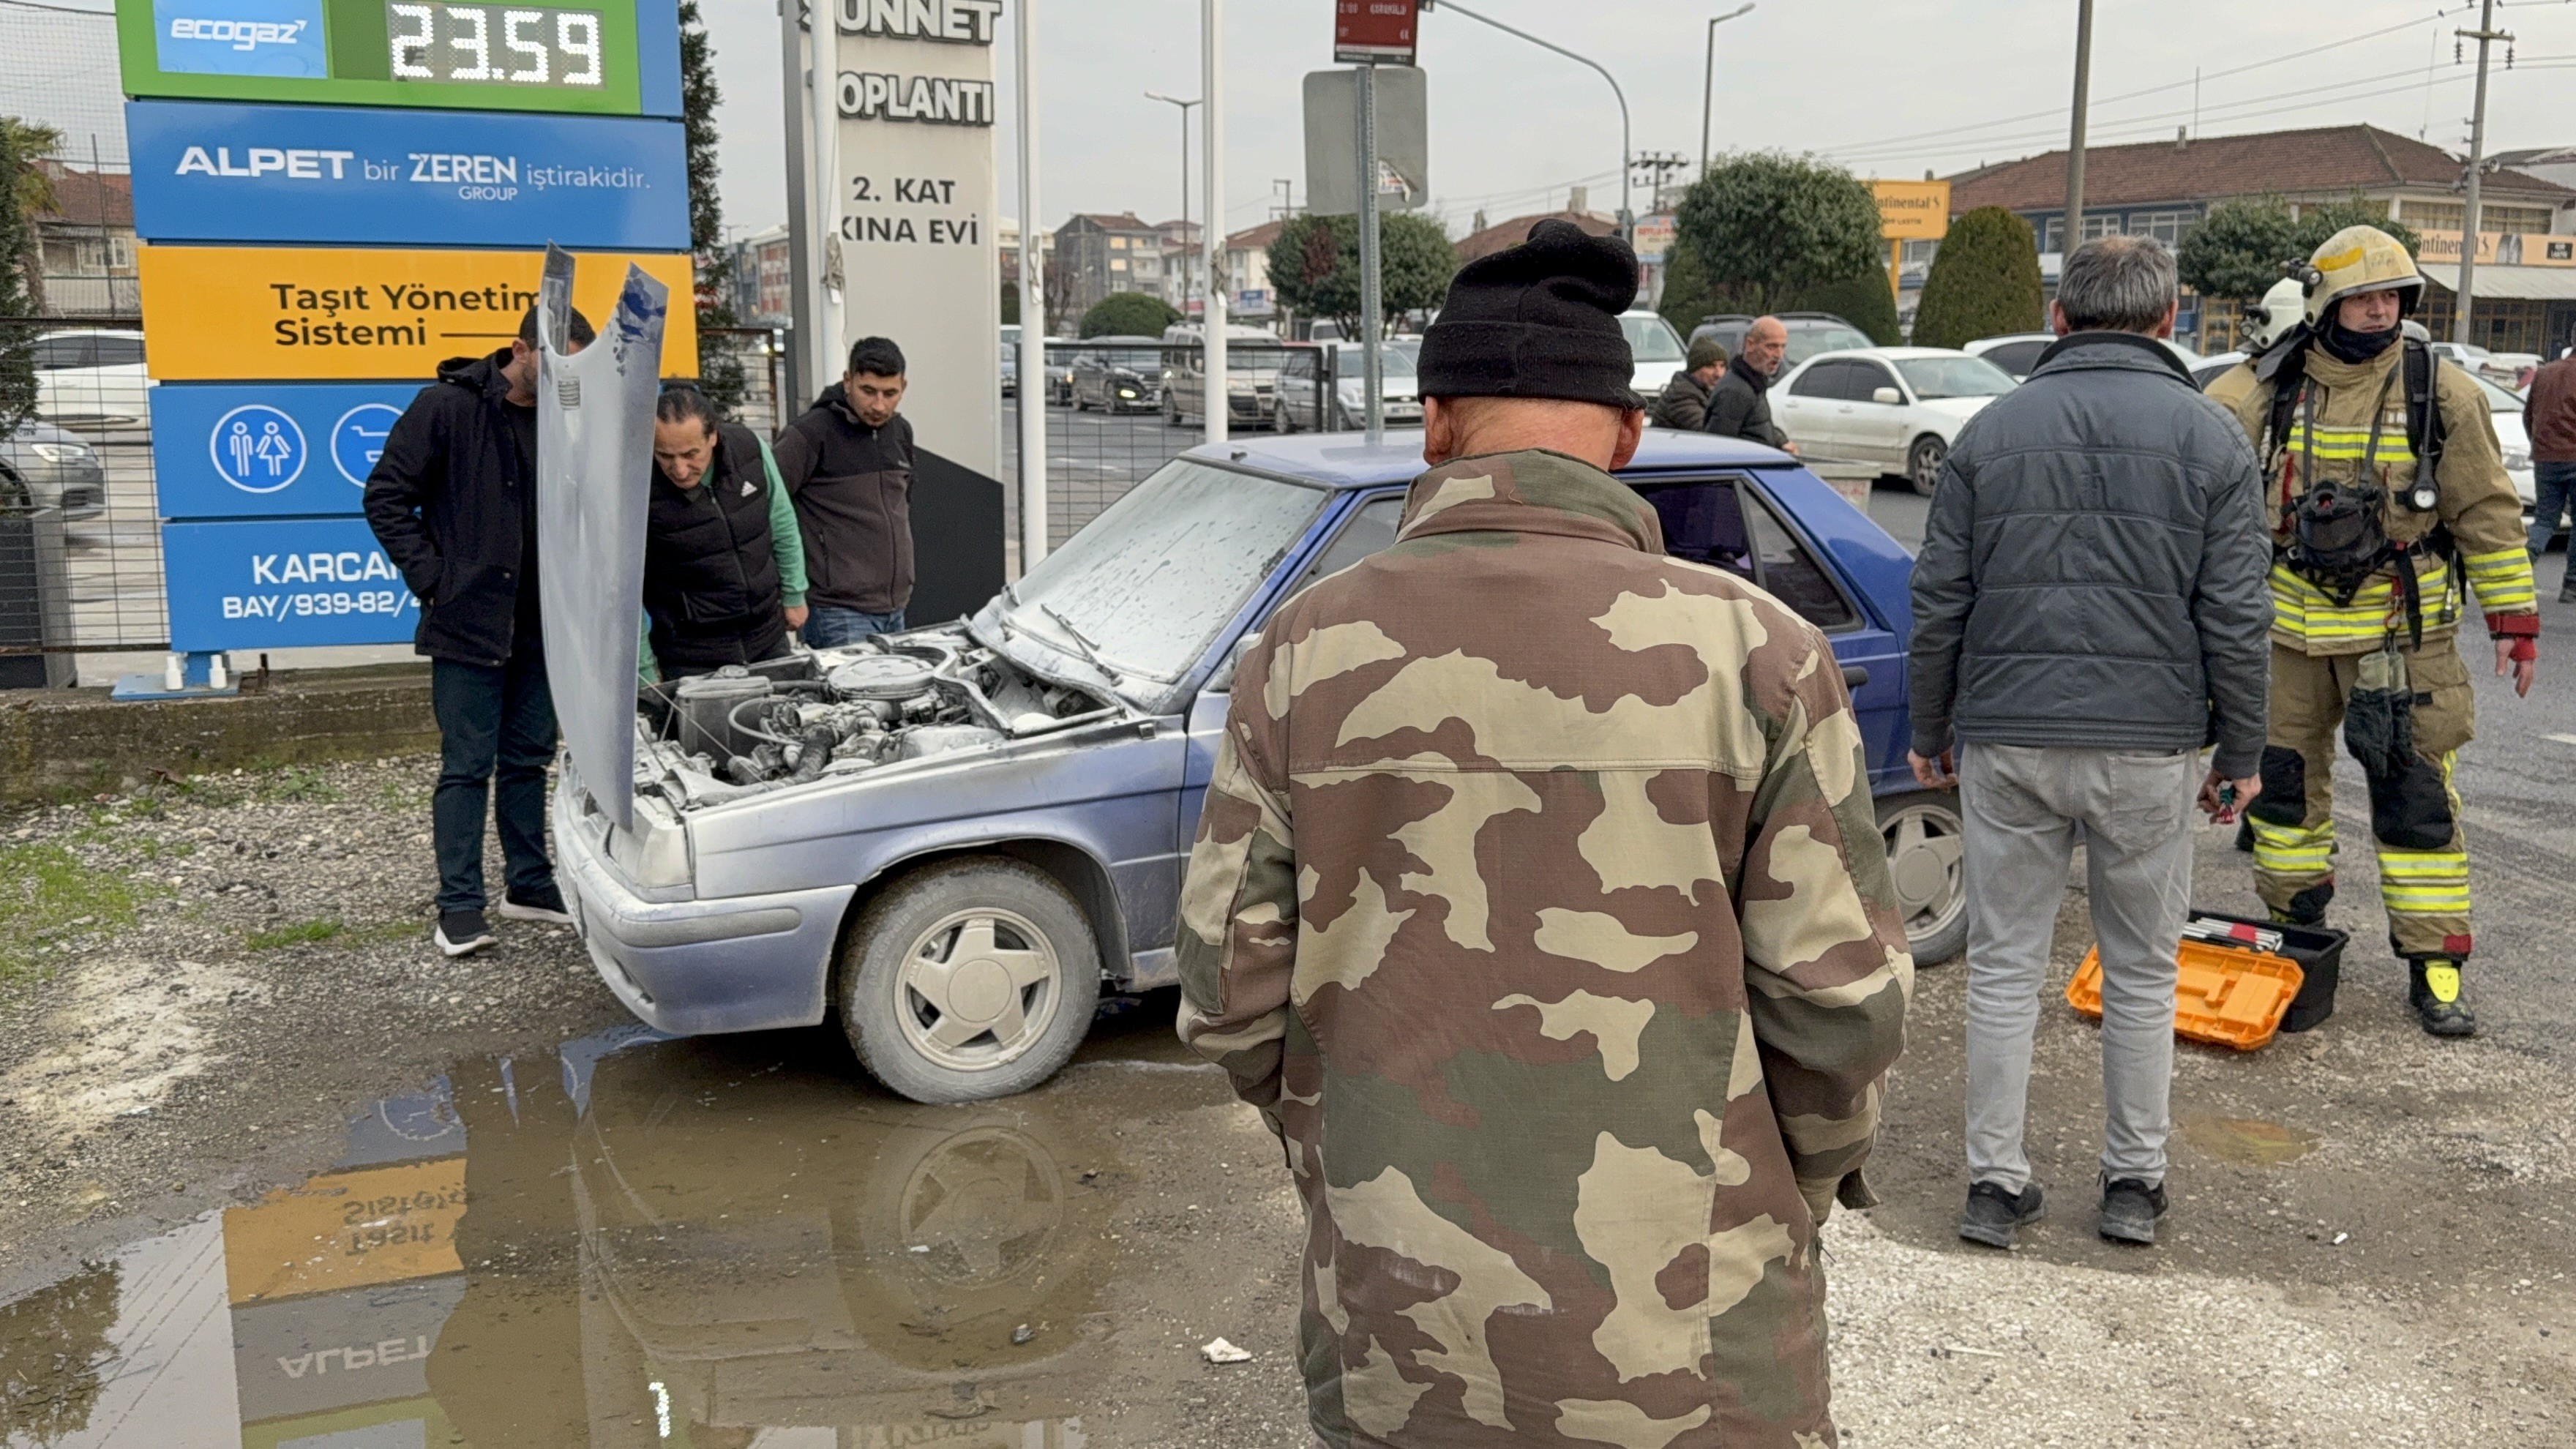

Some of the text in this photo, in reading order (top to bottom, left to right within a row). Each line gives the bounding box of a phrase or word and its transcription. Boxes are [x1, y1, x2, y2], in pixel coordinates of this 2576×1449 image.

[171, 18, 298, 50] ecogaz
[392, 4, 601, 85] 23.59
[836, 72, 993, 126] OPLANTI
[176, 146, 651, 190] ALPET bir ZEREN iştirakidir.
[458, 185, 518, 201] GROUP
[853, 176, 955, 204] 2. KAT
[1876, 195, 1931, 211] ntinental
[929, 213, 977, 244] EVİ
[270, 283, 370, 318] Taşıt
[274, 317, 426, 346] Sistemi
